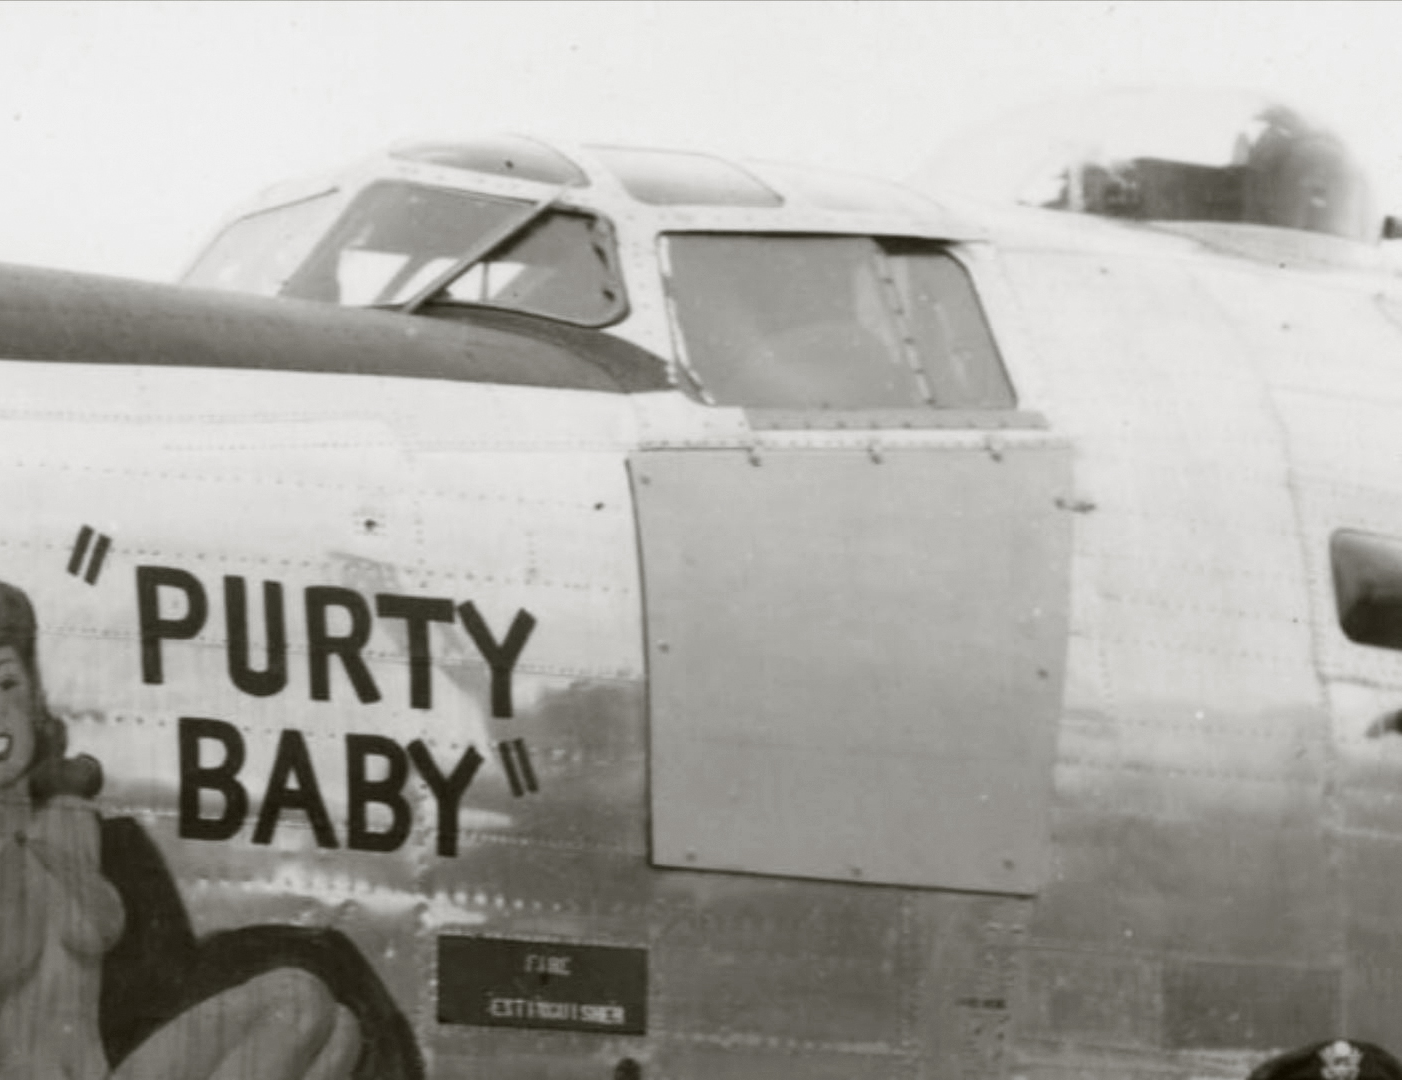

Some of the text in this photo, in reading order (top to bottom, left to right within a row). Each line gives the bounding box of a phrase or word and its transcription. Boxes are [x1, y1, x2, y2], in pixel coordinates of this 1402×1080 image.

[66, 525, 537, 718] "PURTY
[177, 716, 539, 858] BABY"
[524, 954, 572, 976] FIRE
